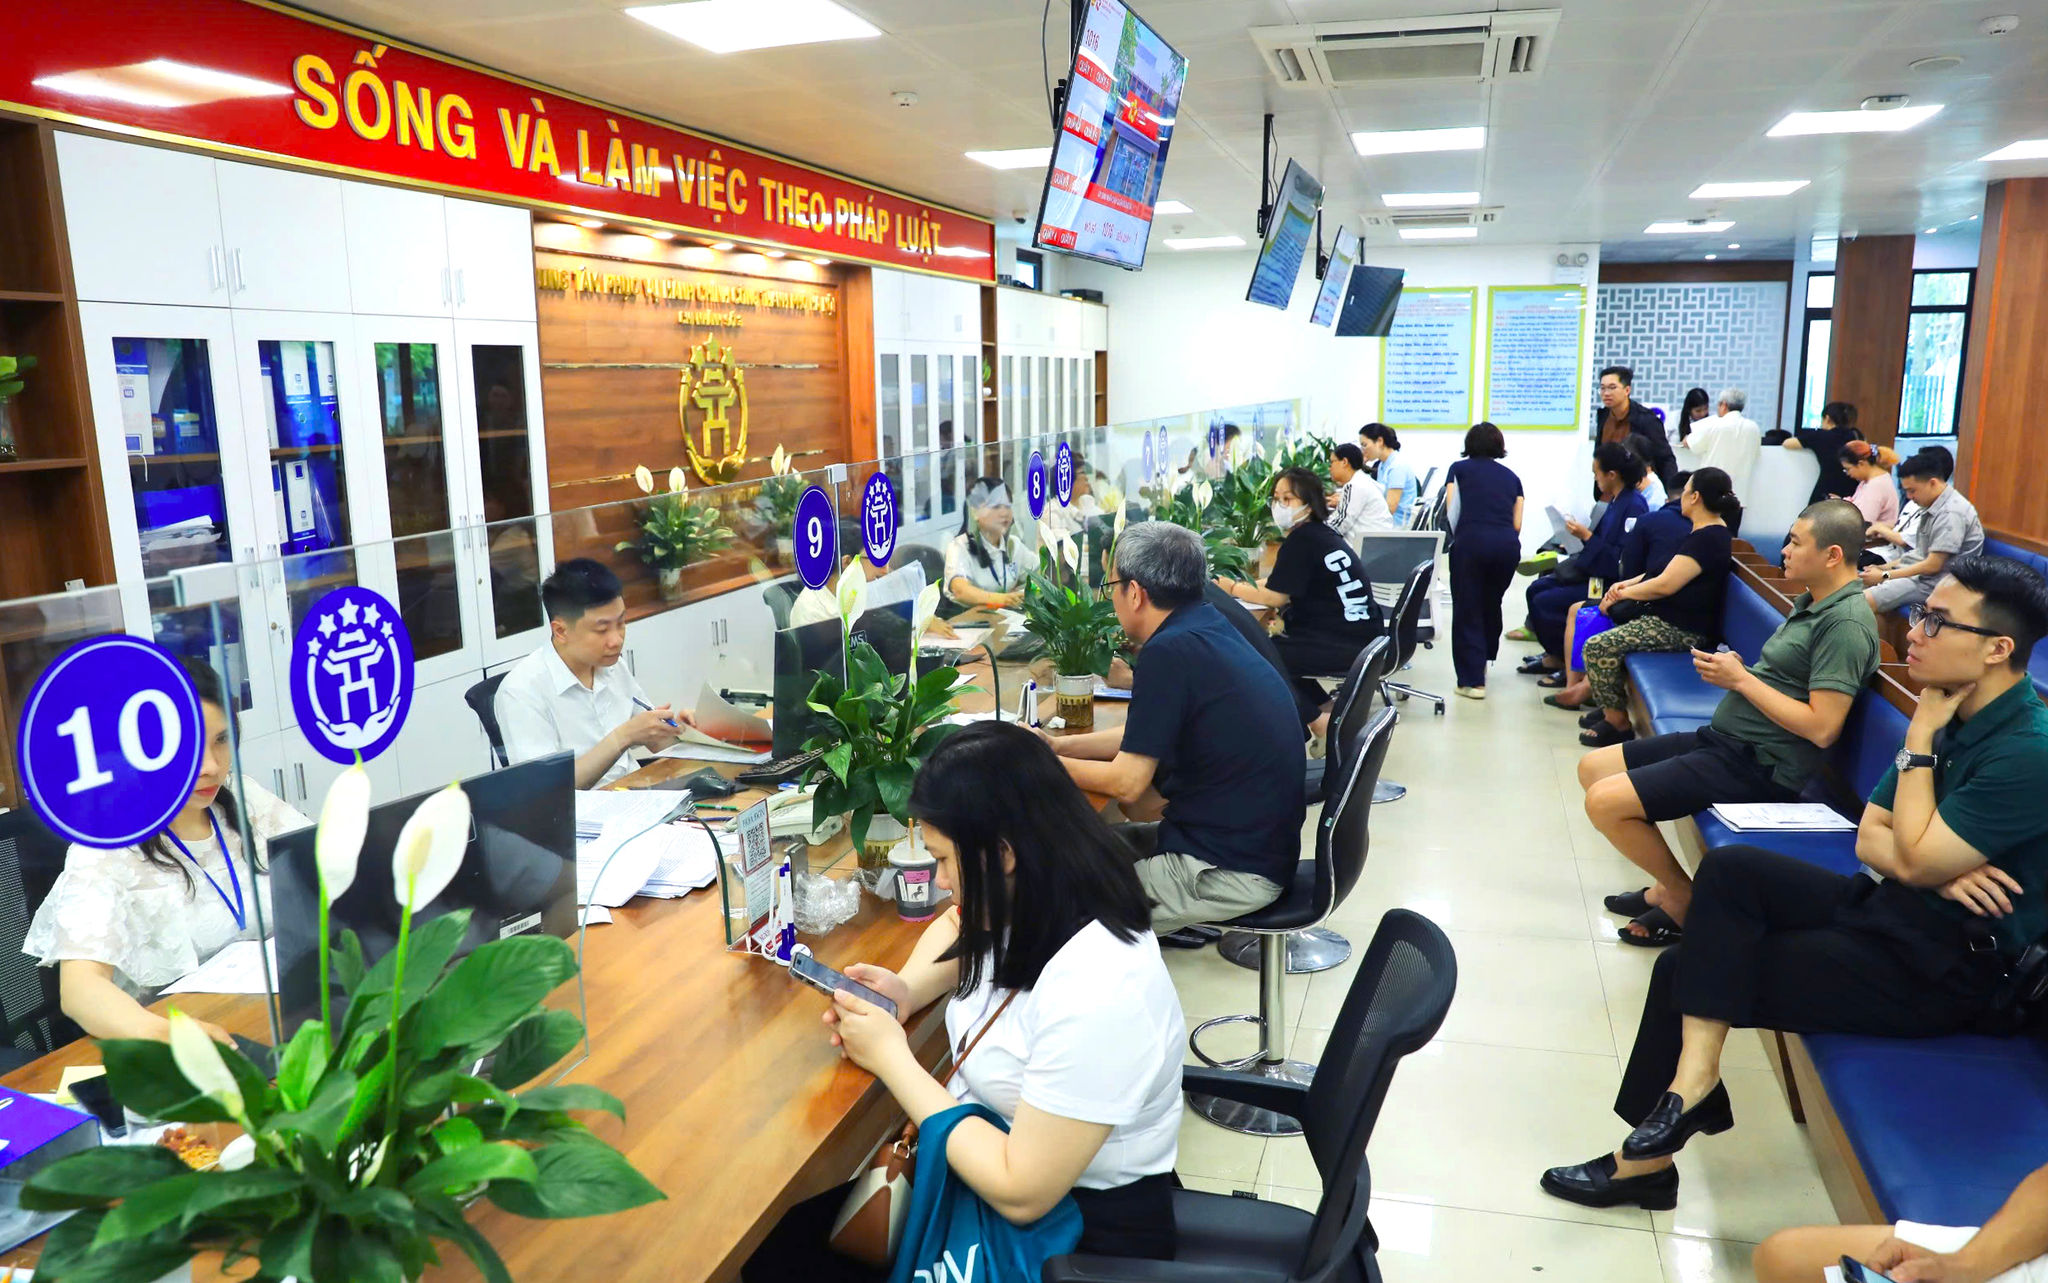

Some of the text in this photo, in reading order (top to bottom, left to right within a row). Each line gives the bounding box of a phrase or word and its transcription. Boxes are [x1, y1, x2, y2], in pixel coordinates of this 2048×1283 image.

[1085, 28, 1100, 51] 1016
[293, 45, 943, 263] SỐNG VÀ LÀM VIỆC THEO PHÁP LUẬT
[1033, 471, 1041, 499] 8
[807, 516, 823, 558] 9
[56, 689, 182, 795] 10
